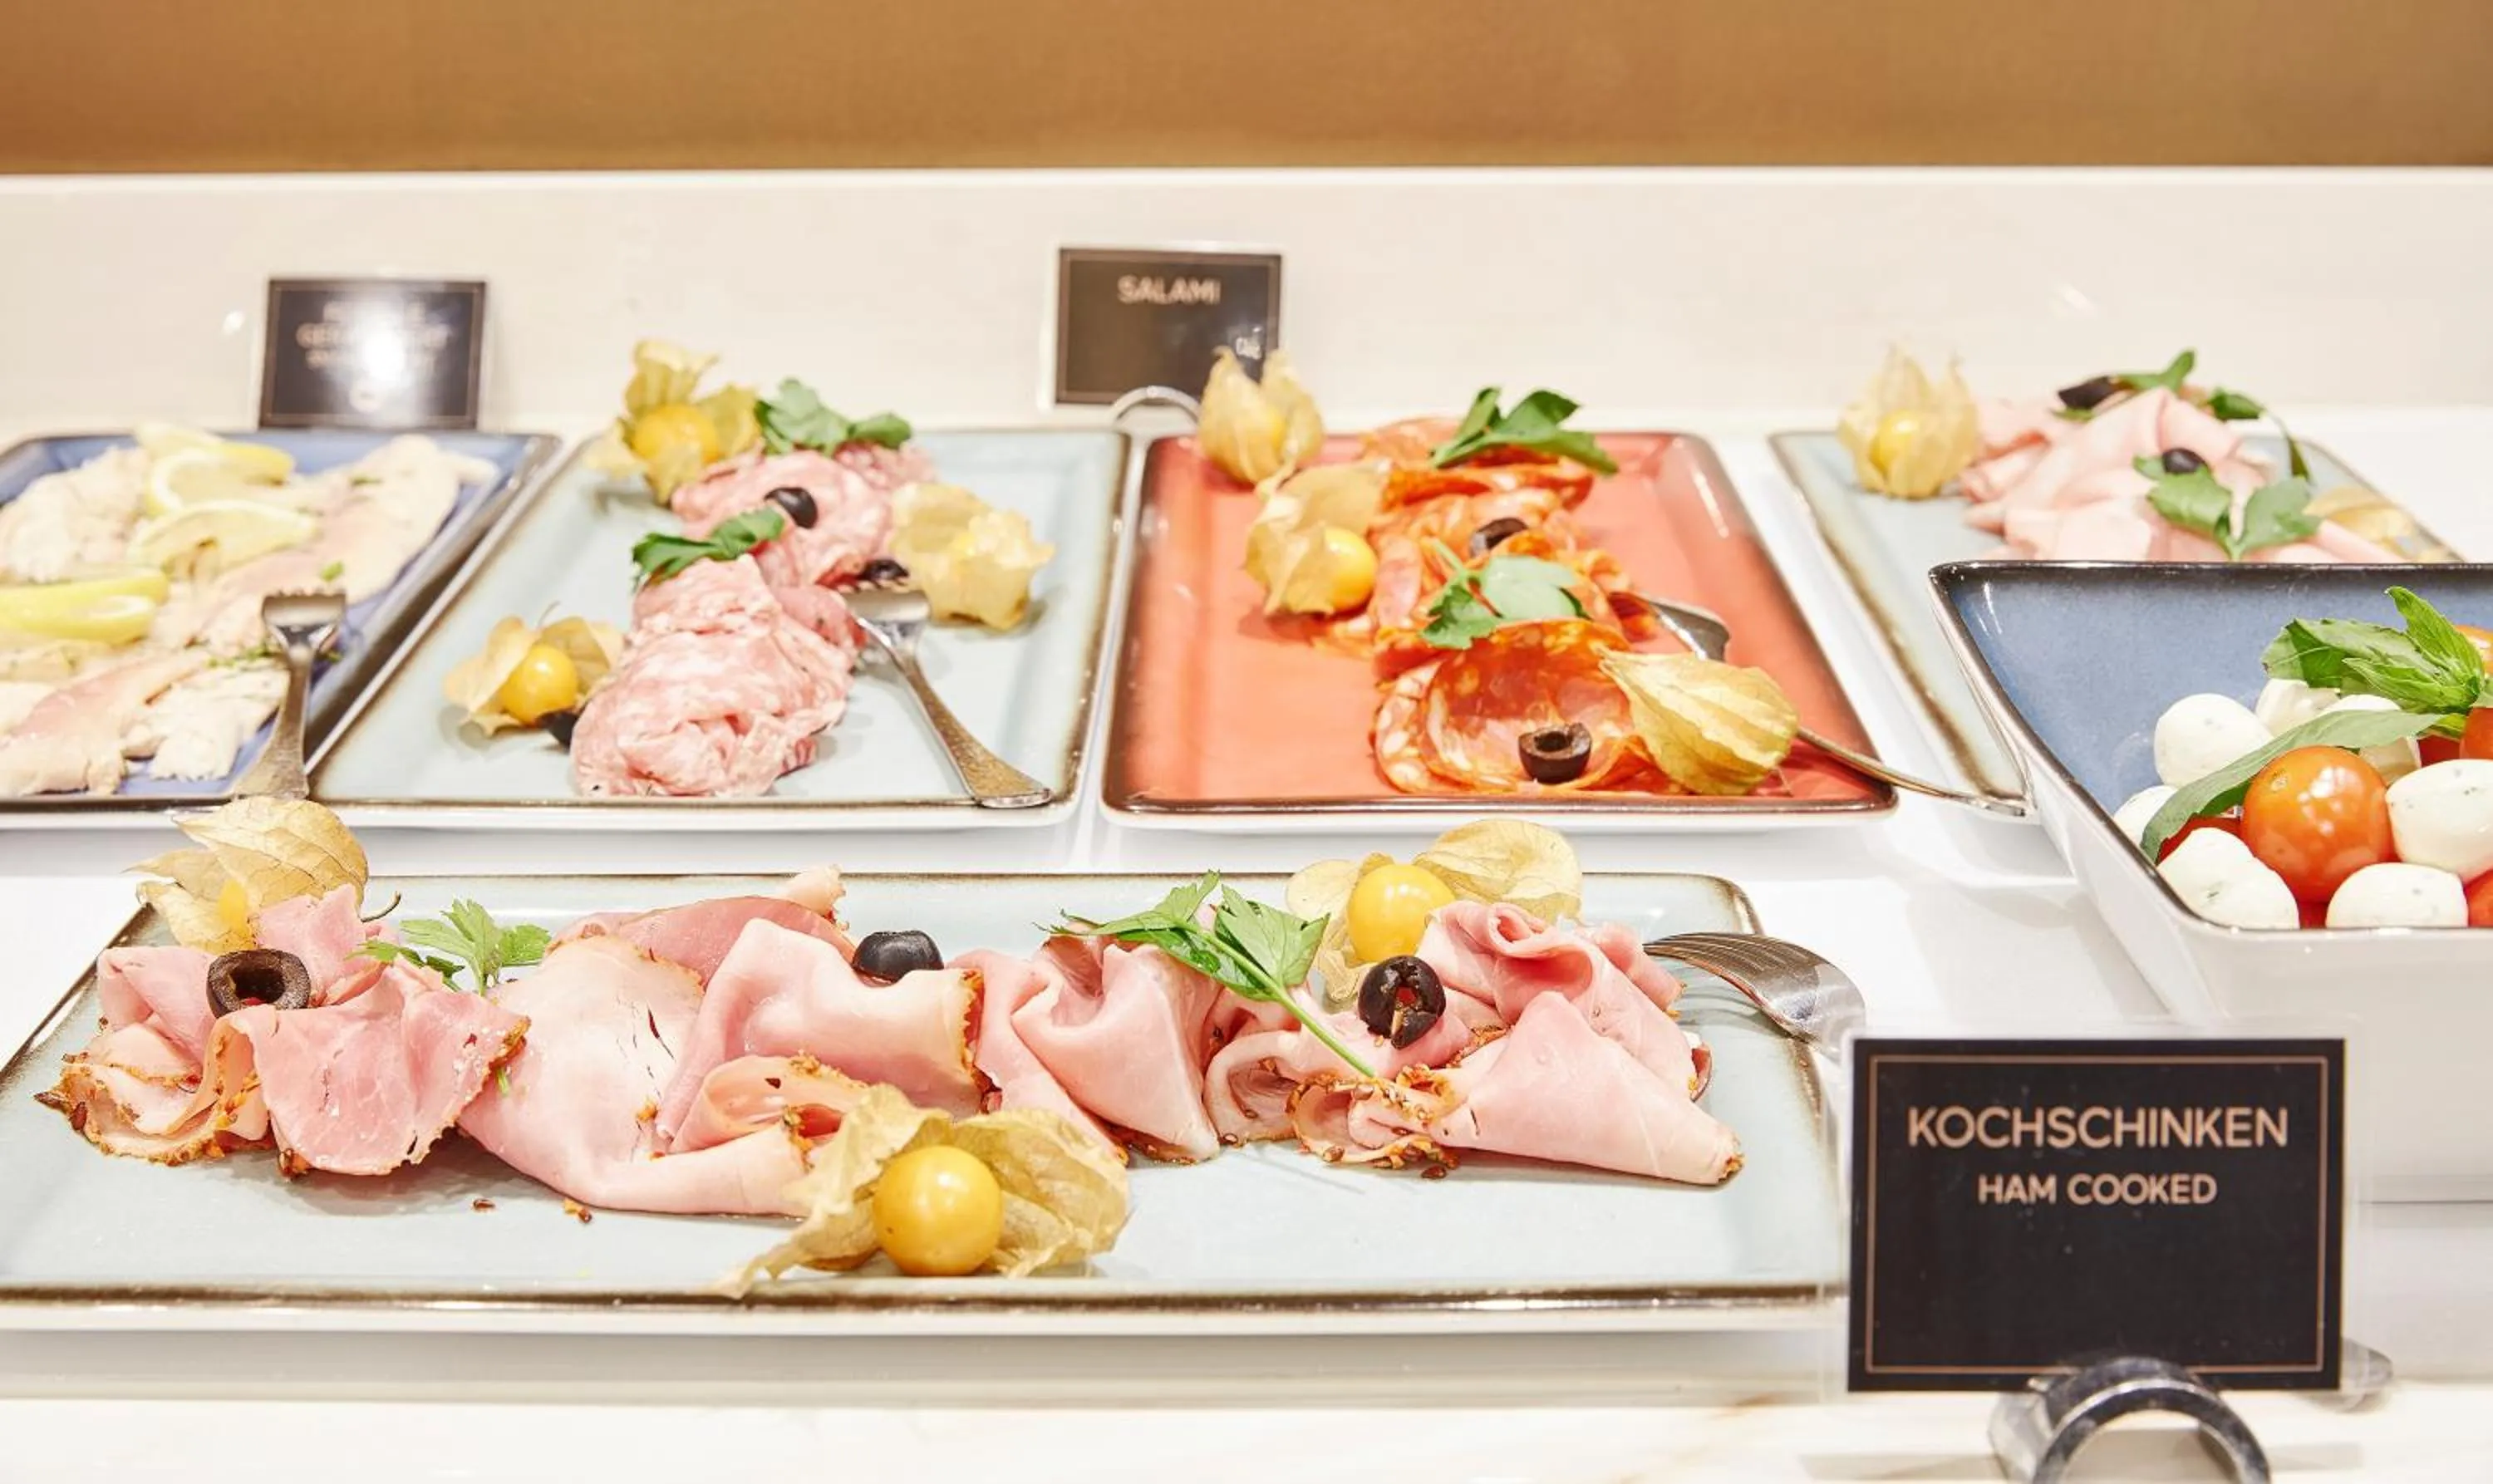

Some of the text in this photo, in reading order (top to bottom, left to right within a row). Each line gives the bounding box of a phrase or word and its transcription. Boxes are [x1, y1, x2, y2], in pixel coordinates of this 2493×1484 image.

[1118, 275, 1221, 304] SALAMI
[1908, 1106, 2288, 1147] KOCHSCHINKEN
[1979, 1173, 2217, 1204] HAM COOKED
